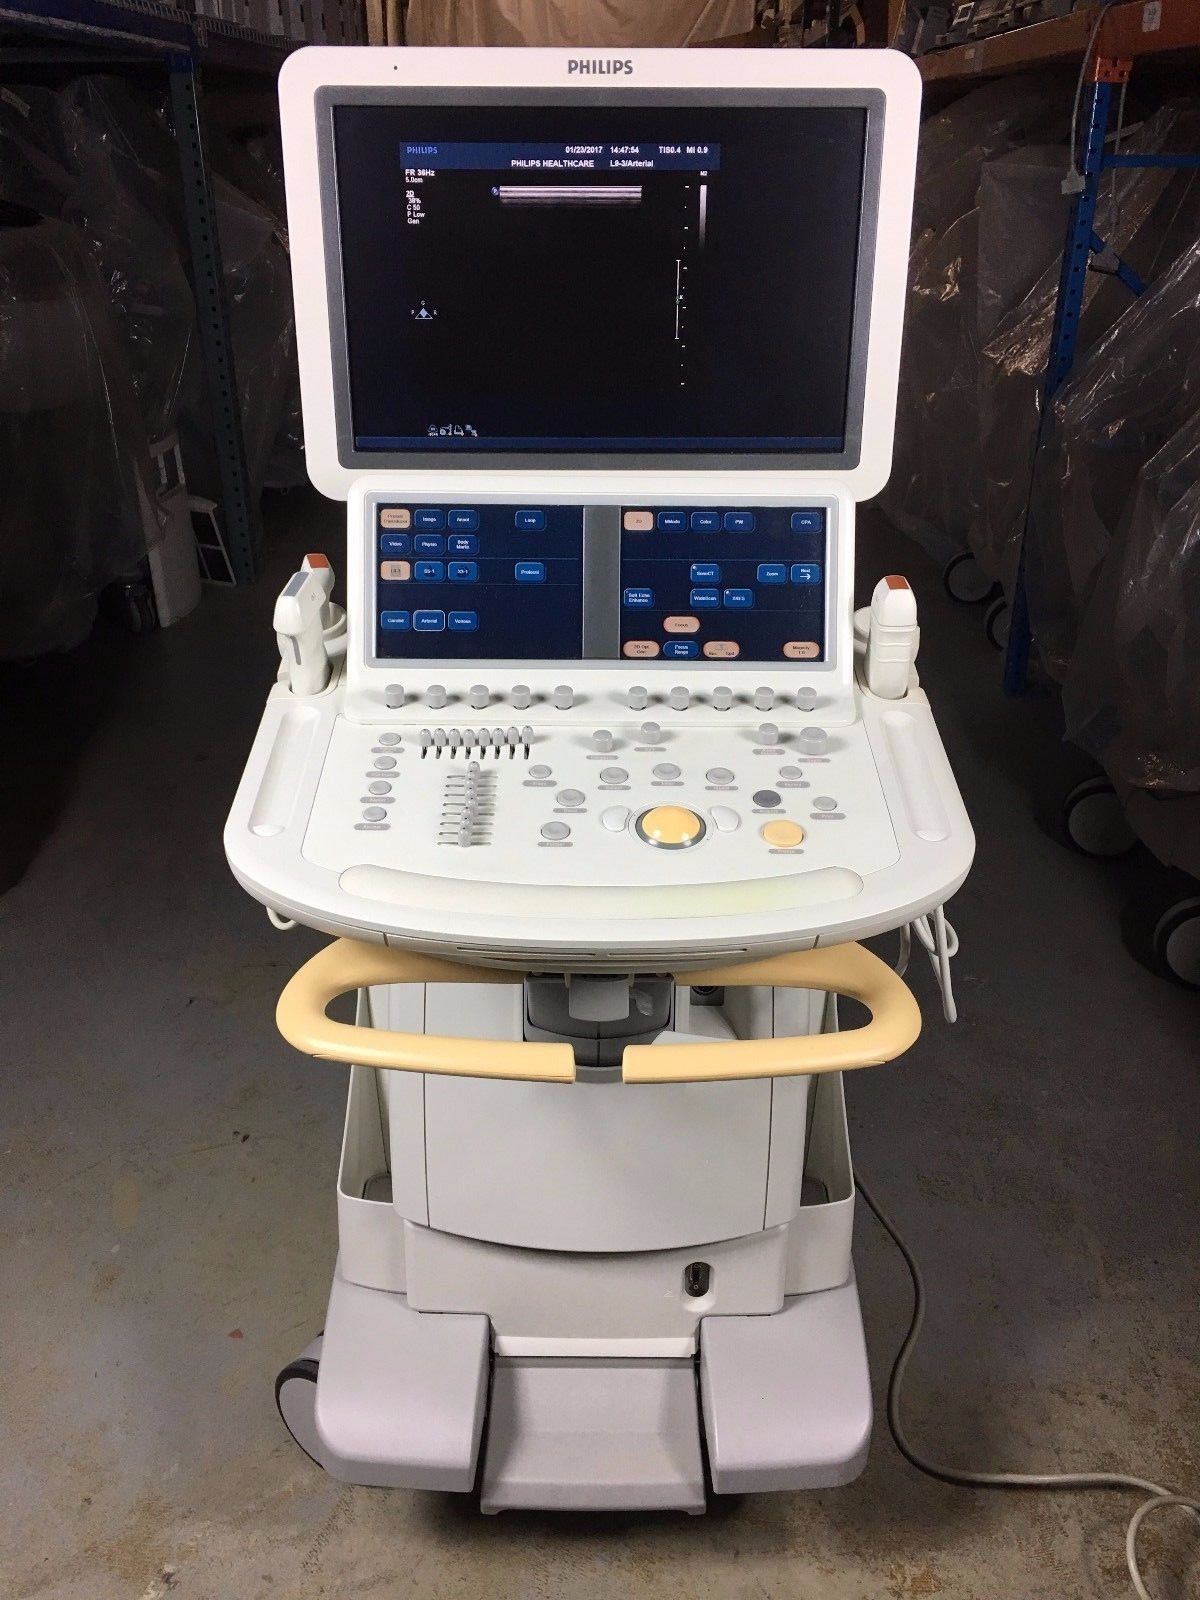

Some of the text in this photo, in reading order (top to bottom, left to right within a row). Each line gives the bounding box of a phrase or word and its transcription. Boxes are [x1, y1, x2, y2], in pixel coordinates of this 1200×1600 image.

[568, 60, 634, 74] PHILIPS
[406, 146, 438, 154] PHILIPS
[565, 146, 603, 154] 01/23/2017
[610, 146, 639, 154] 14:47:54
[511, 160, 541, 168] PHILIPS
[542, 160, 594, 168] HEALTHCARE
[405, 168, 416, 176] FR
